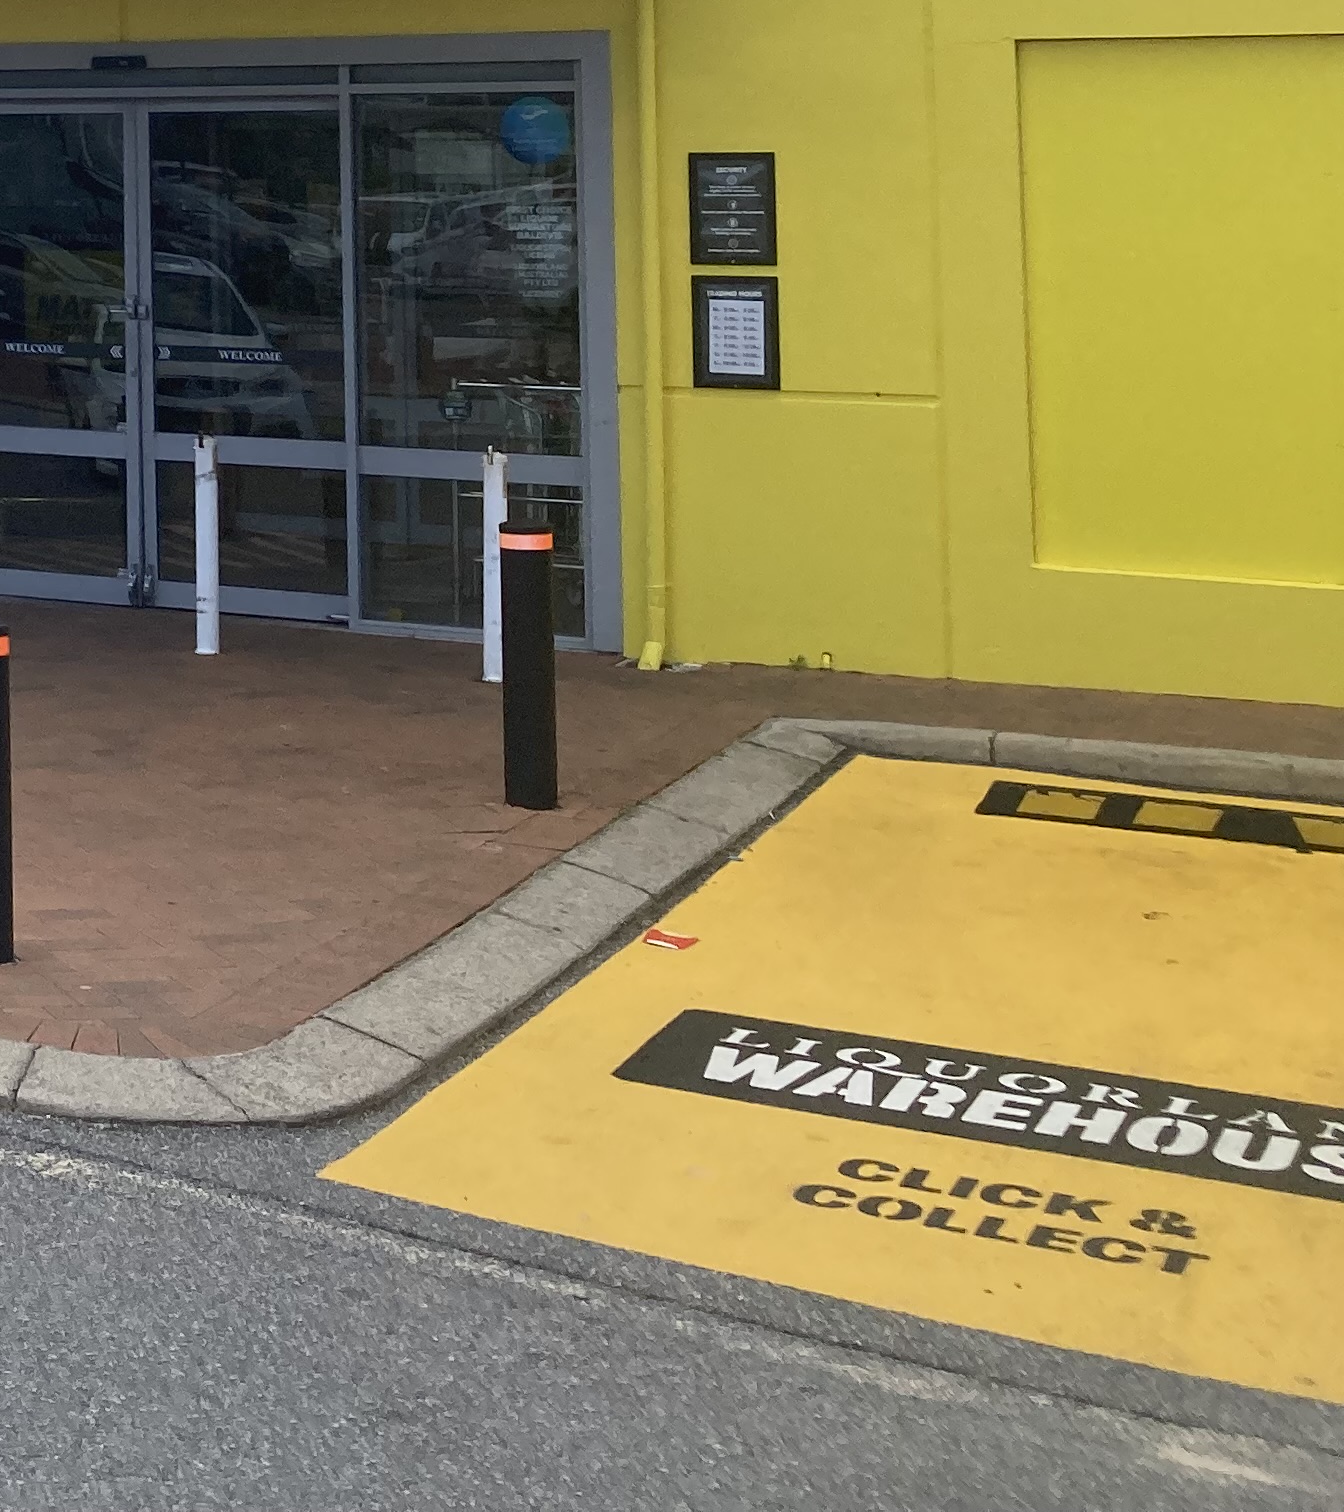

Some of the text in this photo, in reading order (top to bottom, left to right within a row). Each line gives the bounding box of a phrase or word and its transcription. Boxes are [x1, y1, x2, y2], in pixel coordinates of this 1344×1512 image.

[4, 342, 64, 355] WELCOME
[218, 348, 283, 362] WELCOME
[836, 1157, 1199, 1239] CLICK &
[792, 1183, 1211, 1276] COLLECT
